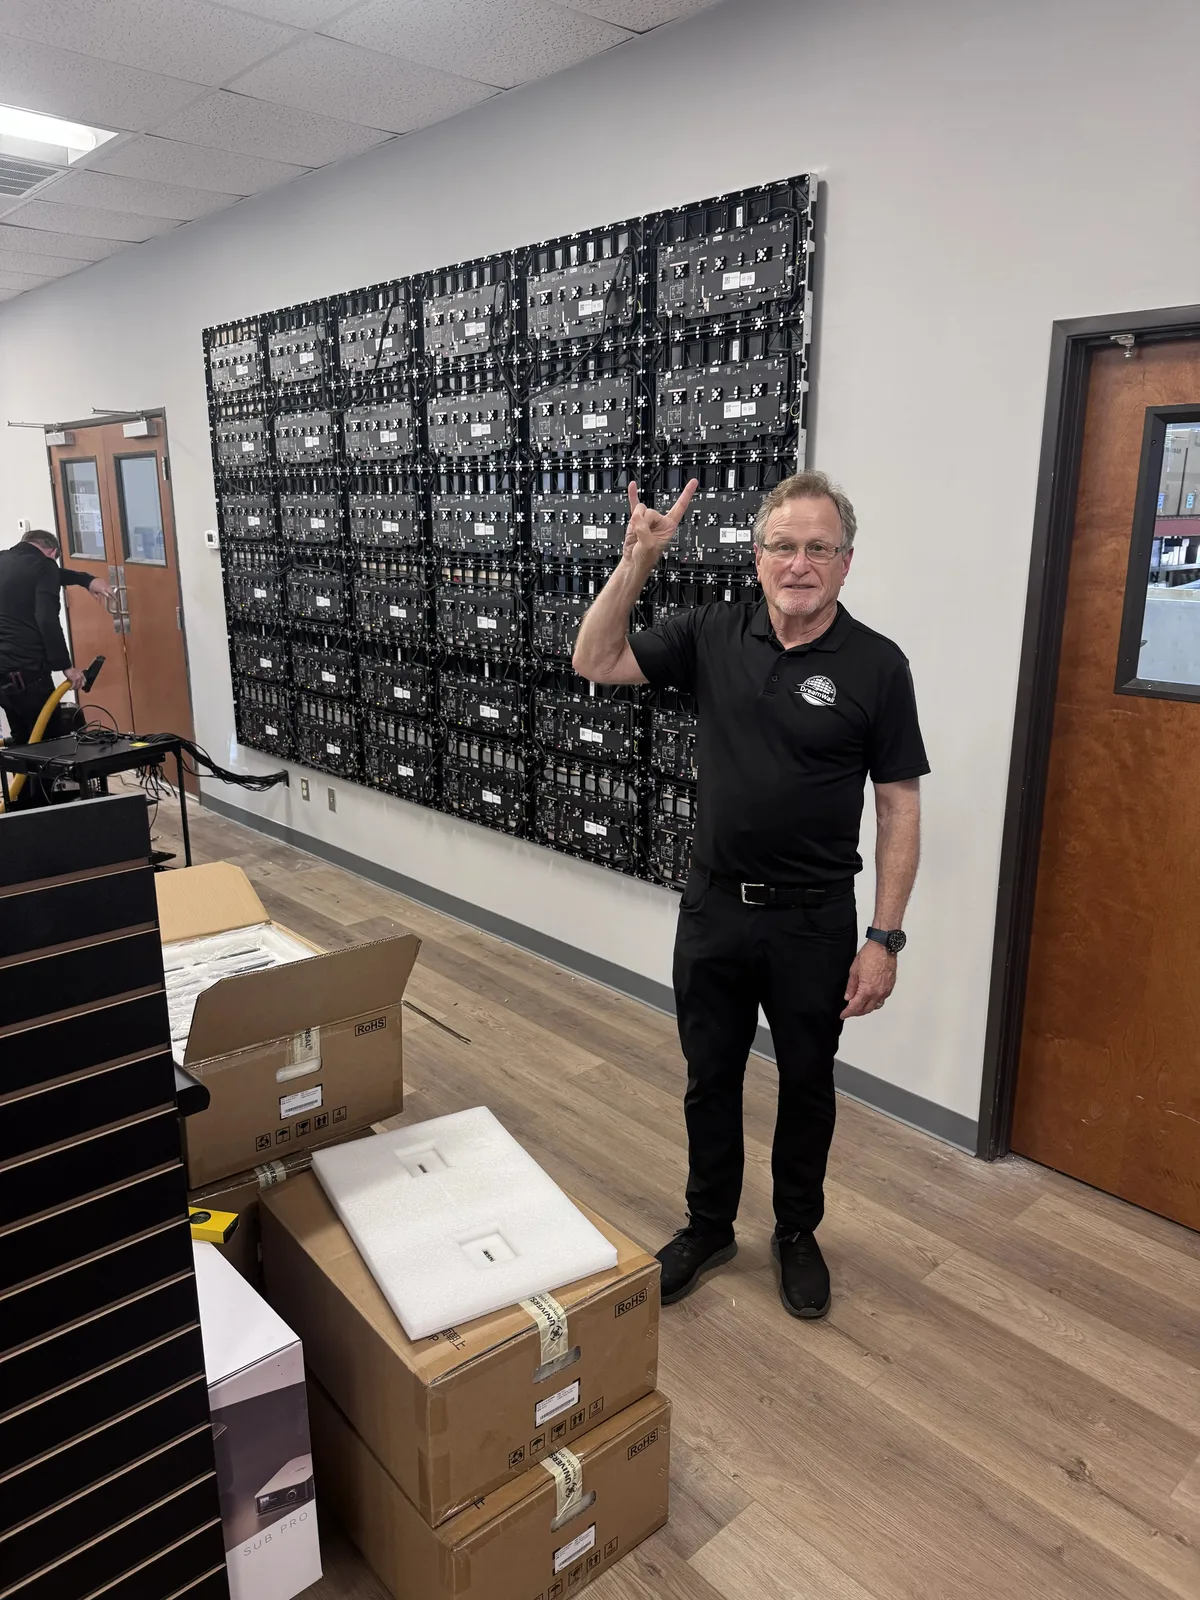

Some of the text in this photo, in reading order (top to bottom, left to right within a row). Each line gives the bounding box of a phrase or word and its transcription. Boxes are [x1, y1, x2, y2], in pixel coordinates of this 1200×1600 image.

[357, 1019, 384, 1034] RoHS
[617, 1291, 645, 1315] RoHS
[630, 1431, 656, 1457] RoHS
[243, 1511, 308, 1557] SUB PRO
